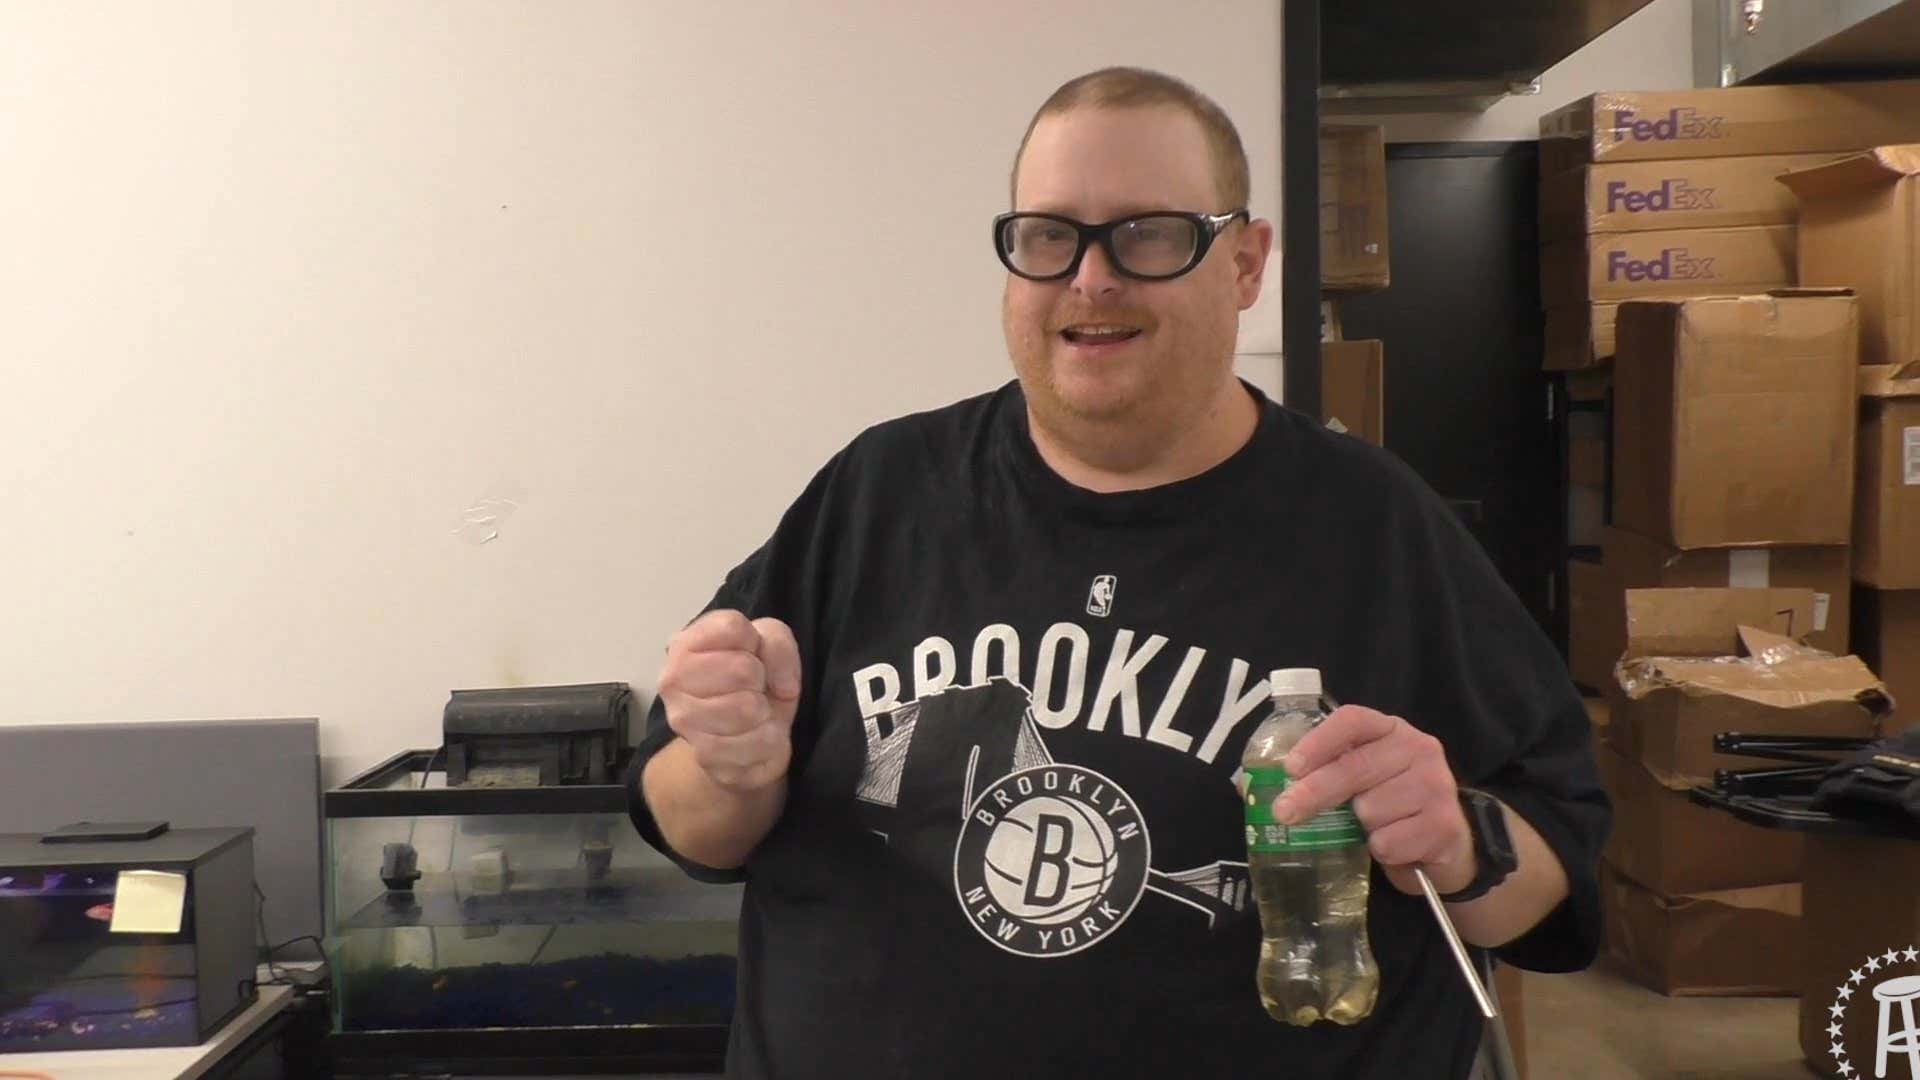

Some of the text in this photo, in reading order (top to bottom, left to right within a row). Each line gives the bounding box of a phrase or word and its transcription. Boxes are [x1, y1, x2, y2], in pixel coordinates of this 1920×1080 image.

[1614, 108, 1725, 142] FedEx
[1607, 179, 1716, 213] FedEx
[1608, 249, 1715, 282] FedEx
[976, 772, 1139, 841] BROOKLYN
[1023, 813, 1074, 907] B
[965, 889, 1121, 950] NEW YORK
